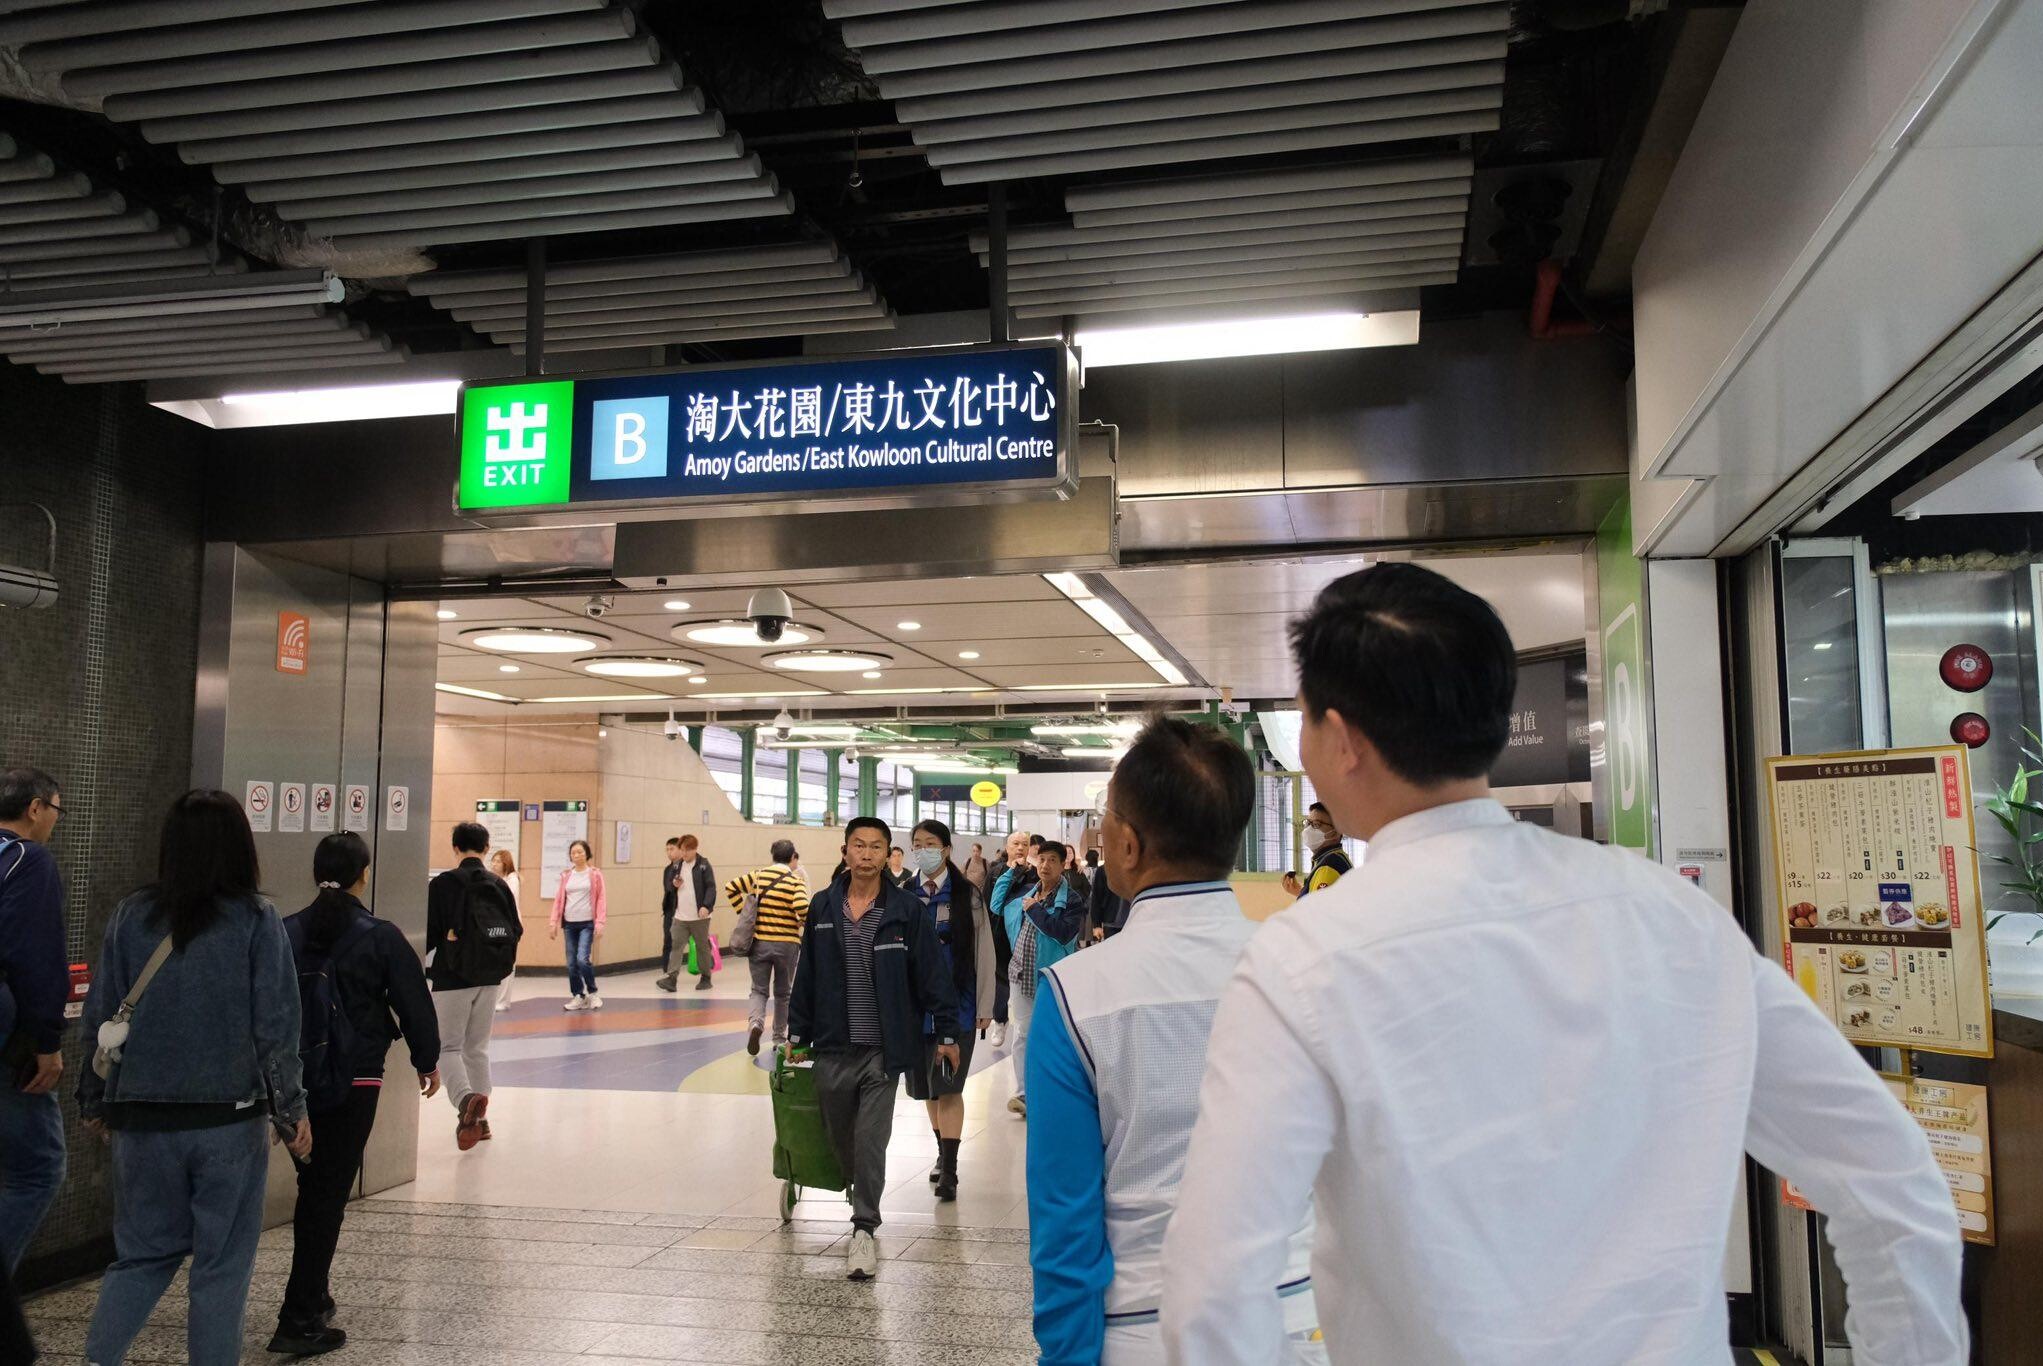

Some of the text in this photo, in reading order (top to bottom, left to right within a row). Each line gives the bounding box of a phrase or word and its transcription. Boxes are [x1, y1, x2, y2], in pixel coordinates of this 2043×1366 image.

[686, 370, 1056, 443] 淘大花園/東九文化中心
[614, 412, 647, 465] B
[685, 452, 733, 481] Amoy
[848, 441, 922, 468] Kowloon
[925, 436, 992, 463] Cultural
[996, 437, 1054, 460] Centre
[483, 463, 546, 487] EXIT
[1509, 710, 1537, 734] 增值
[1508, 734, 1544, 747] Add Value
[1614, 661, 1636, 811] B
[1817, 872, 1831, 880] $22
[1849, 872, 1864, 880] $20
[1881, 872, 1896, 880] $30
[1914, 872, 1930, 880] $22
[1787, 880, 1802, 888] $15
[1908, 1026, 1924, 1034] $48
